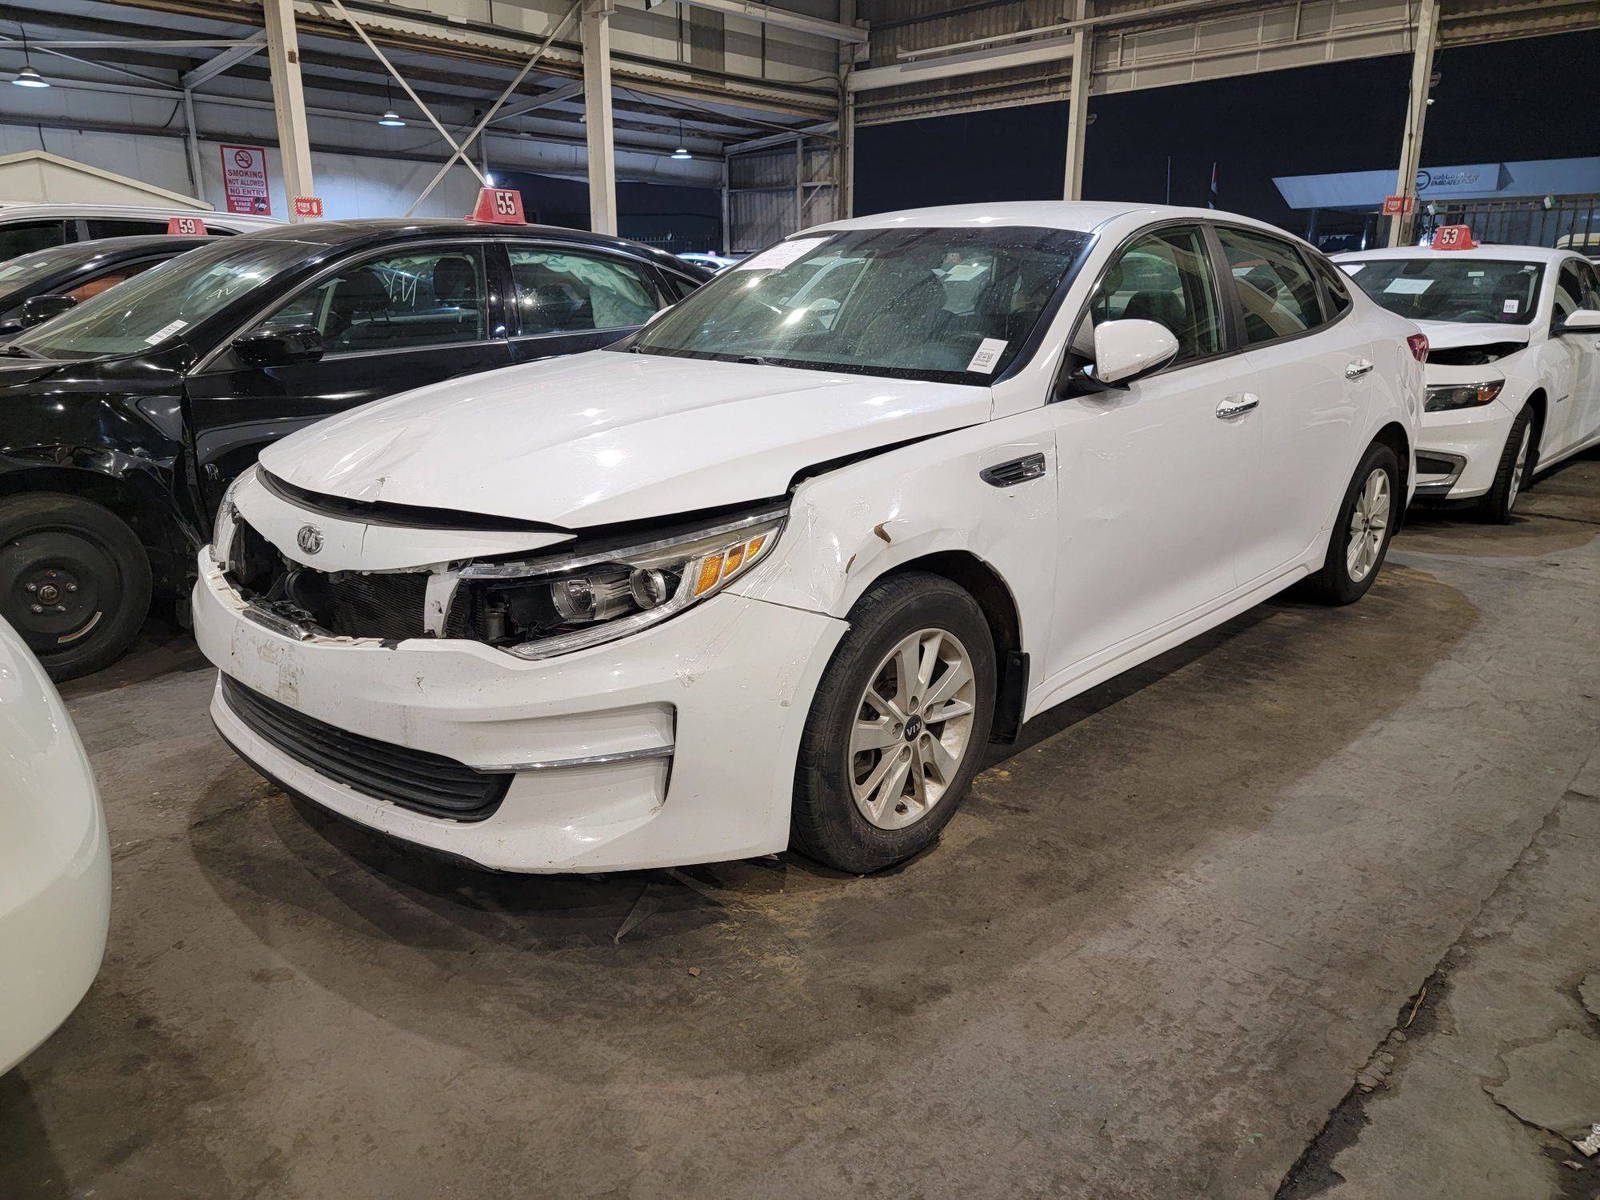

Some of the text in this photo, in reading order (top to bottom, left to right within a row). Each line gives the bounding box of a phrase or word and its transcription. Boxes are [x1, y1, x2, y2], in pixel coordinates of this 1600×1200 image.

[227, 169, 264, 179] SMOKING
[228, 178, 265, 187] NOT ALLOWED
[242, 188, 265, 197] ENTRY
[495, 191, 516, 216] 55
[180, 219, 196, 233] 59
[1441, 228, 1459, 244] 53
